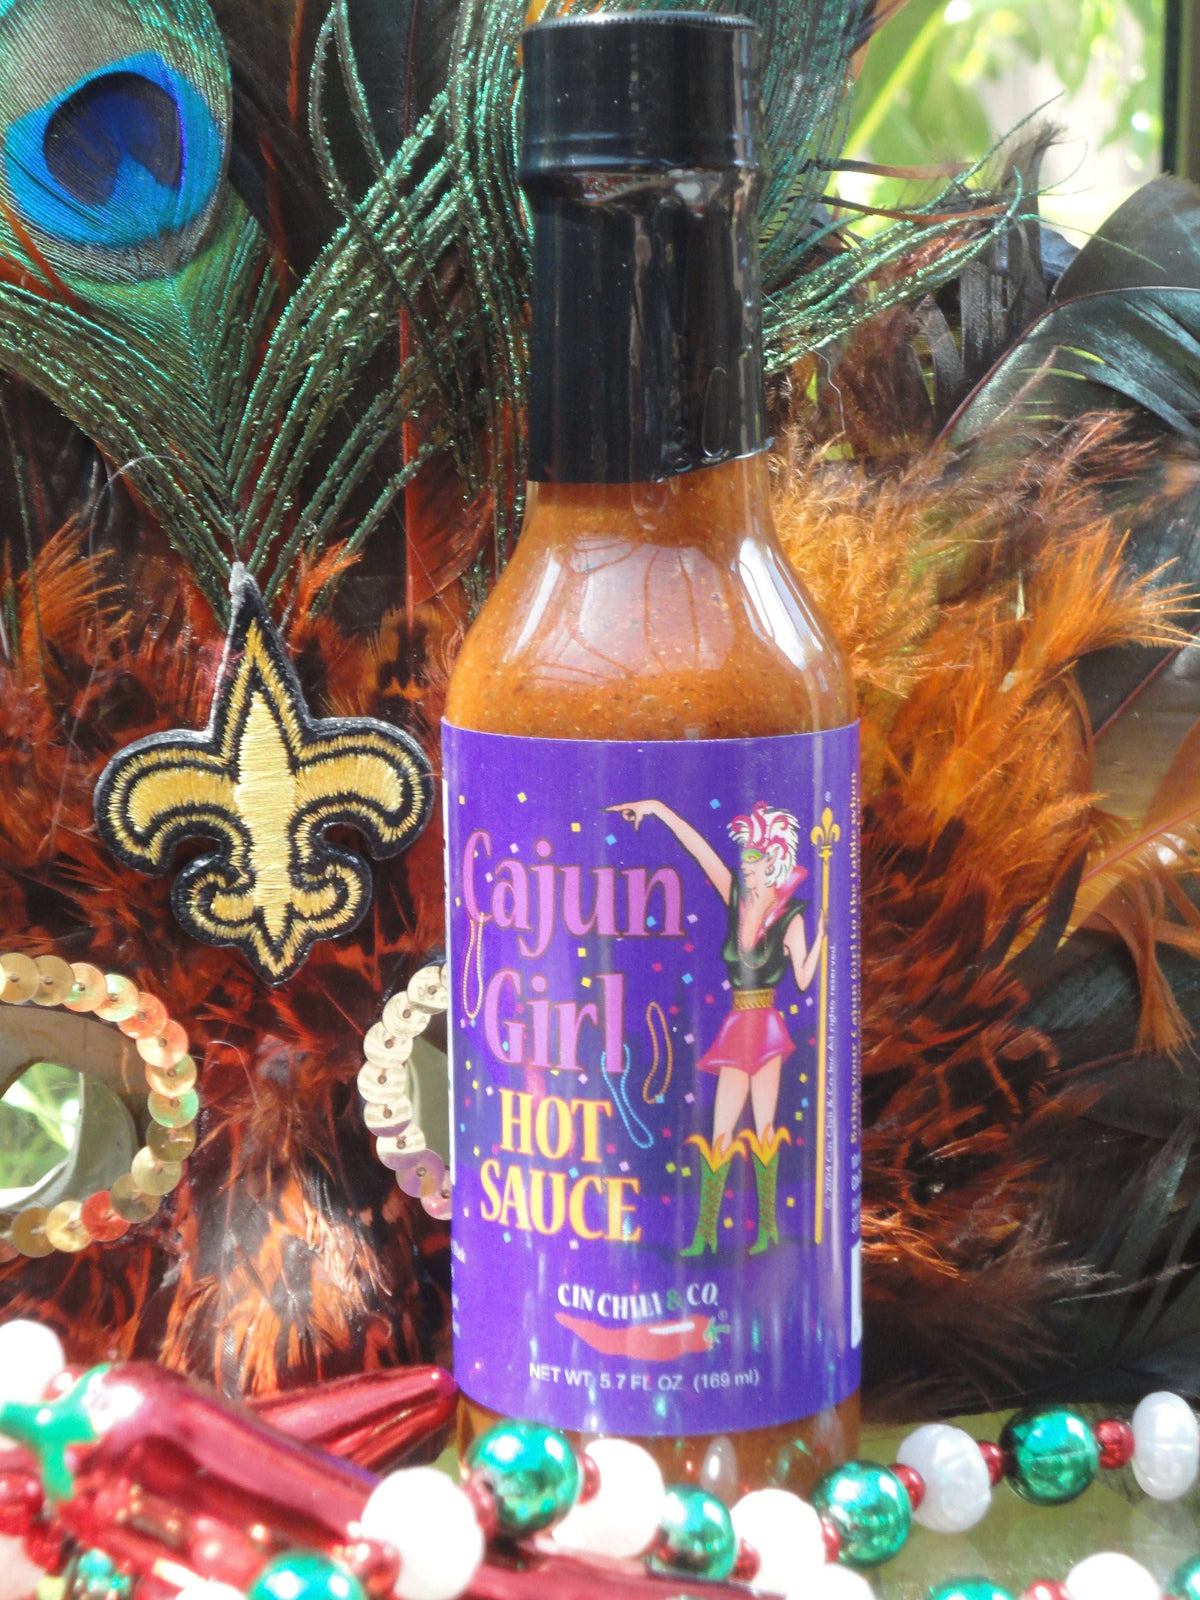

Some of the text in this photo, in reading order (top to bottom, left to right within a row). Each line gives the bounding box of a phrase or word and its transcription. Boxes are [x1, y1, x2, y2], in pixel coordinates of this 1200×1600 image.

[462, 830, 687, 959] Cajun
[484, 969, 626, 1075] Girl
[828, 1000, 838, 1032] rights
[498, 1087, 612, 1163] HOT
[480, 1158, 643, 1242] SAUCE
[557, 1283, 595, 1312] CIN
[597, 1292, 663, 1320] CHILI
[666, 1289, 681, 1311] &
[529, 1362, 560, 1383] NET
[599, 1373, 625, 1390] 5.7
[630, 1374, 650, 1391] FL
[693, 1373, 729, 1393] (169
[734, 1368, 761, 1387] ml)
